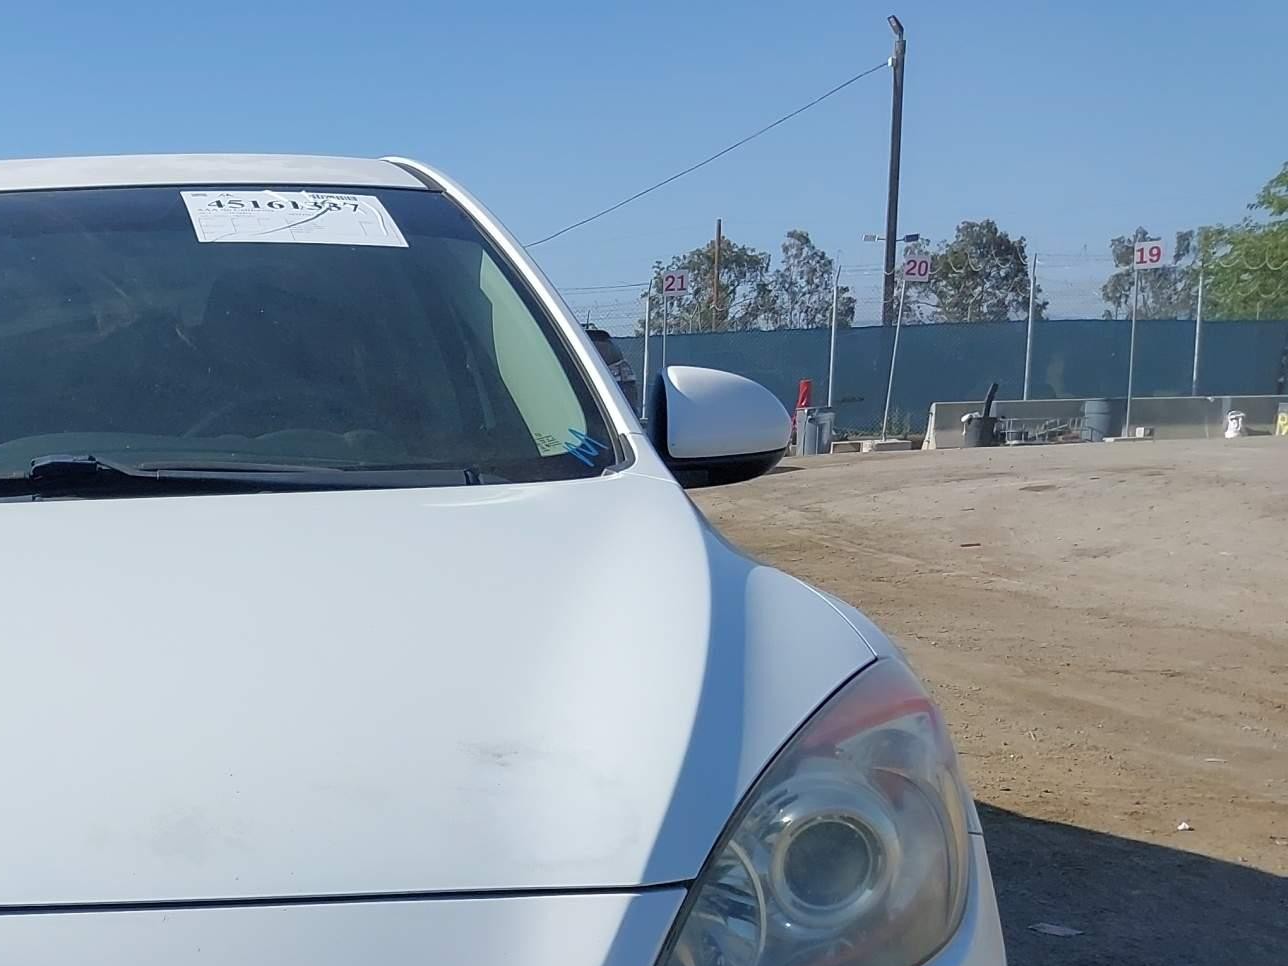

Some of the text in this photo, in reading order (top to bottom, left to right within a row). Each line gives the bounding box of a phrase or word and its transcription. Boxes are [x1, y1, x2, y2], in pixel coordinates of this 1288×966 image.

[1136, 246, 1162, 264] 19
[906, 260, 929, 277] 20
[665, 275, 687, 292] 21
